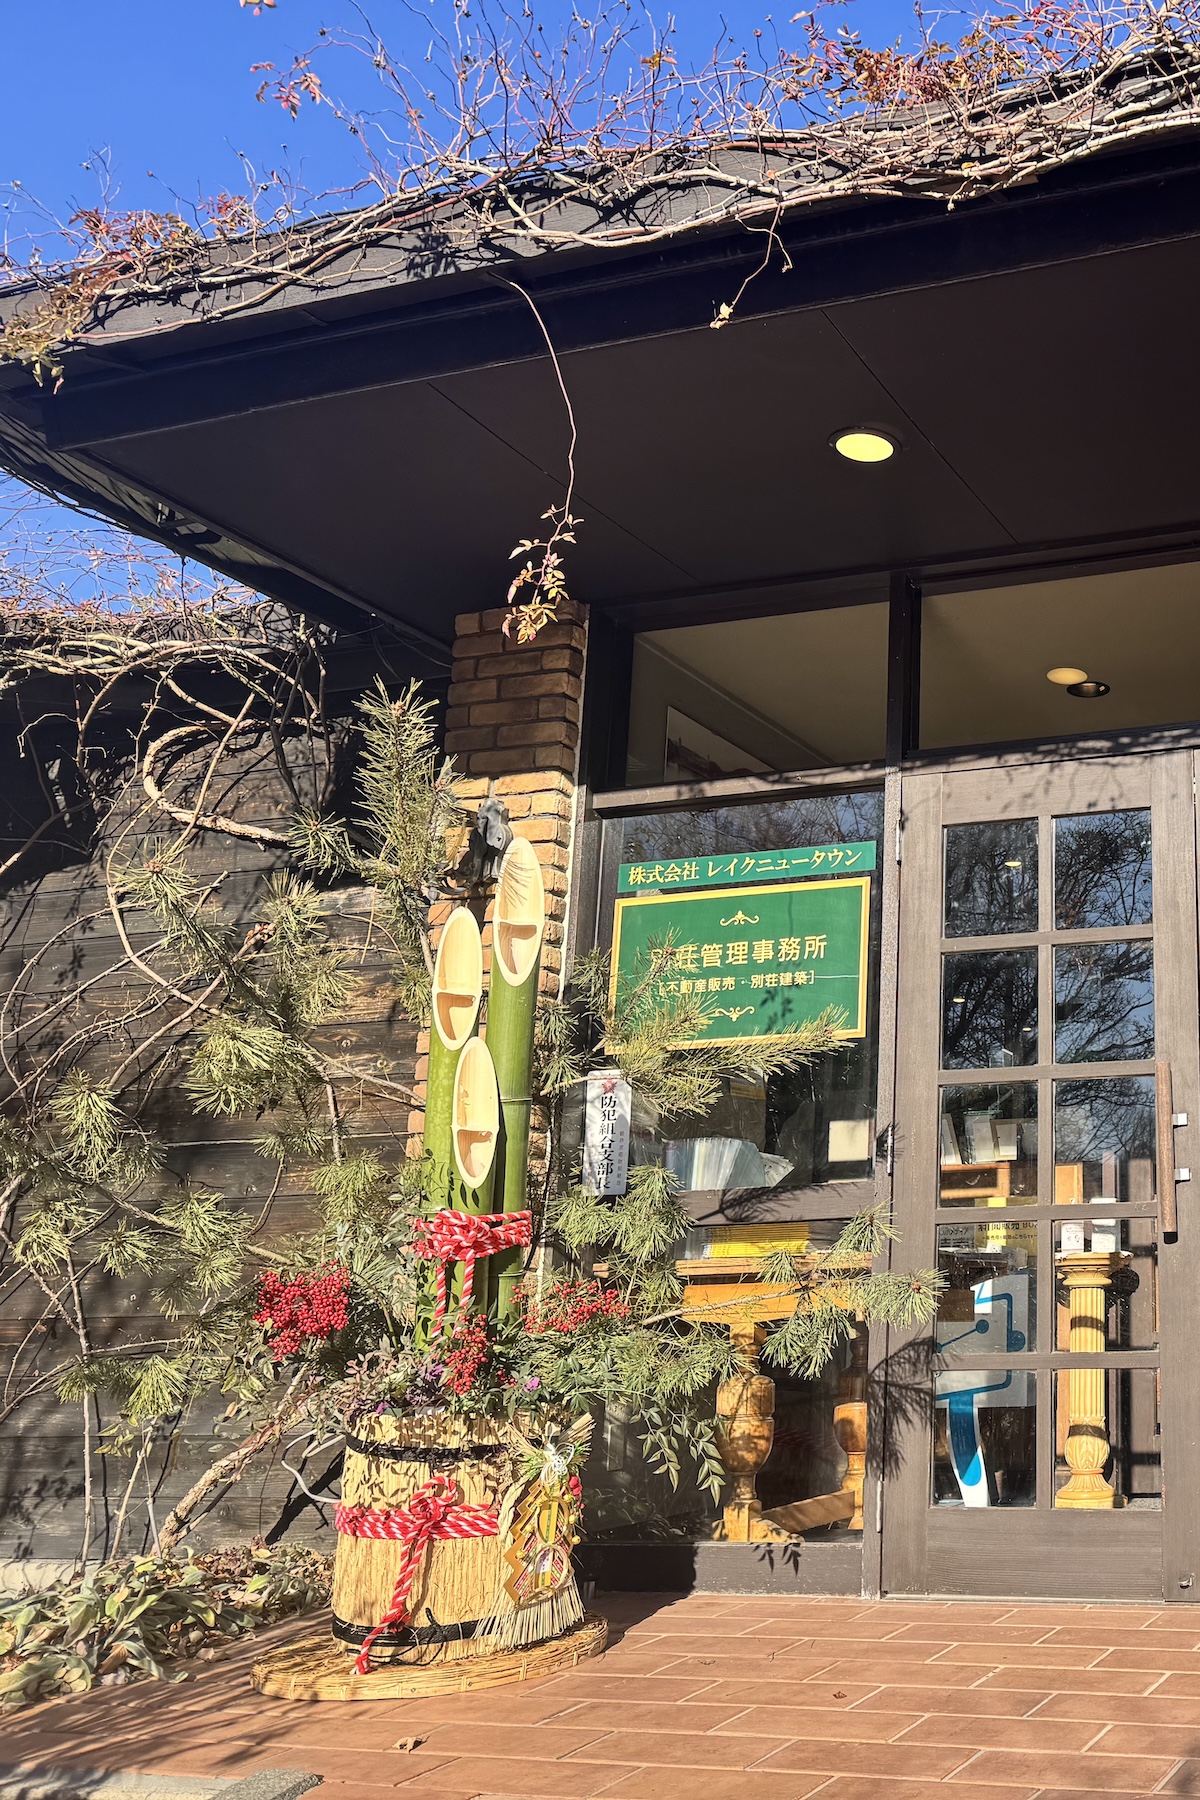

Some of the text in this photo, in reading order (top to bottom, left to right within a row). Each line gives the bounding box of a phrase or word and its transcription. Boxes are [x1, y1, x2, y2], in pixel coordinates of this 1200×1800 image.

[628, 848, 863, 885] 株式会社 レイクニュータウン
[651, 934, 827, 970] 荘管理事務所
